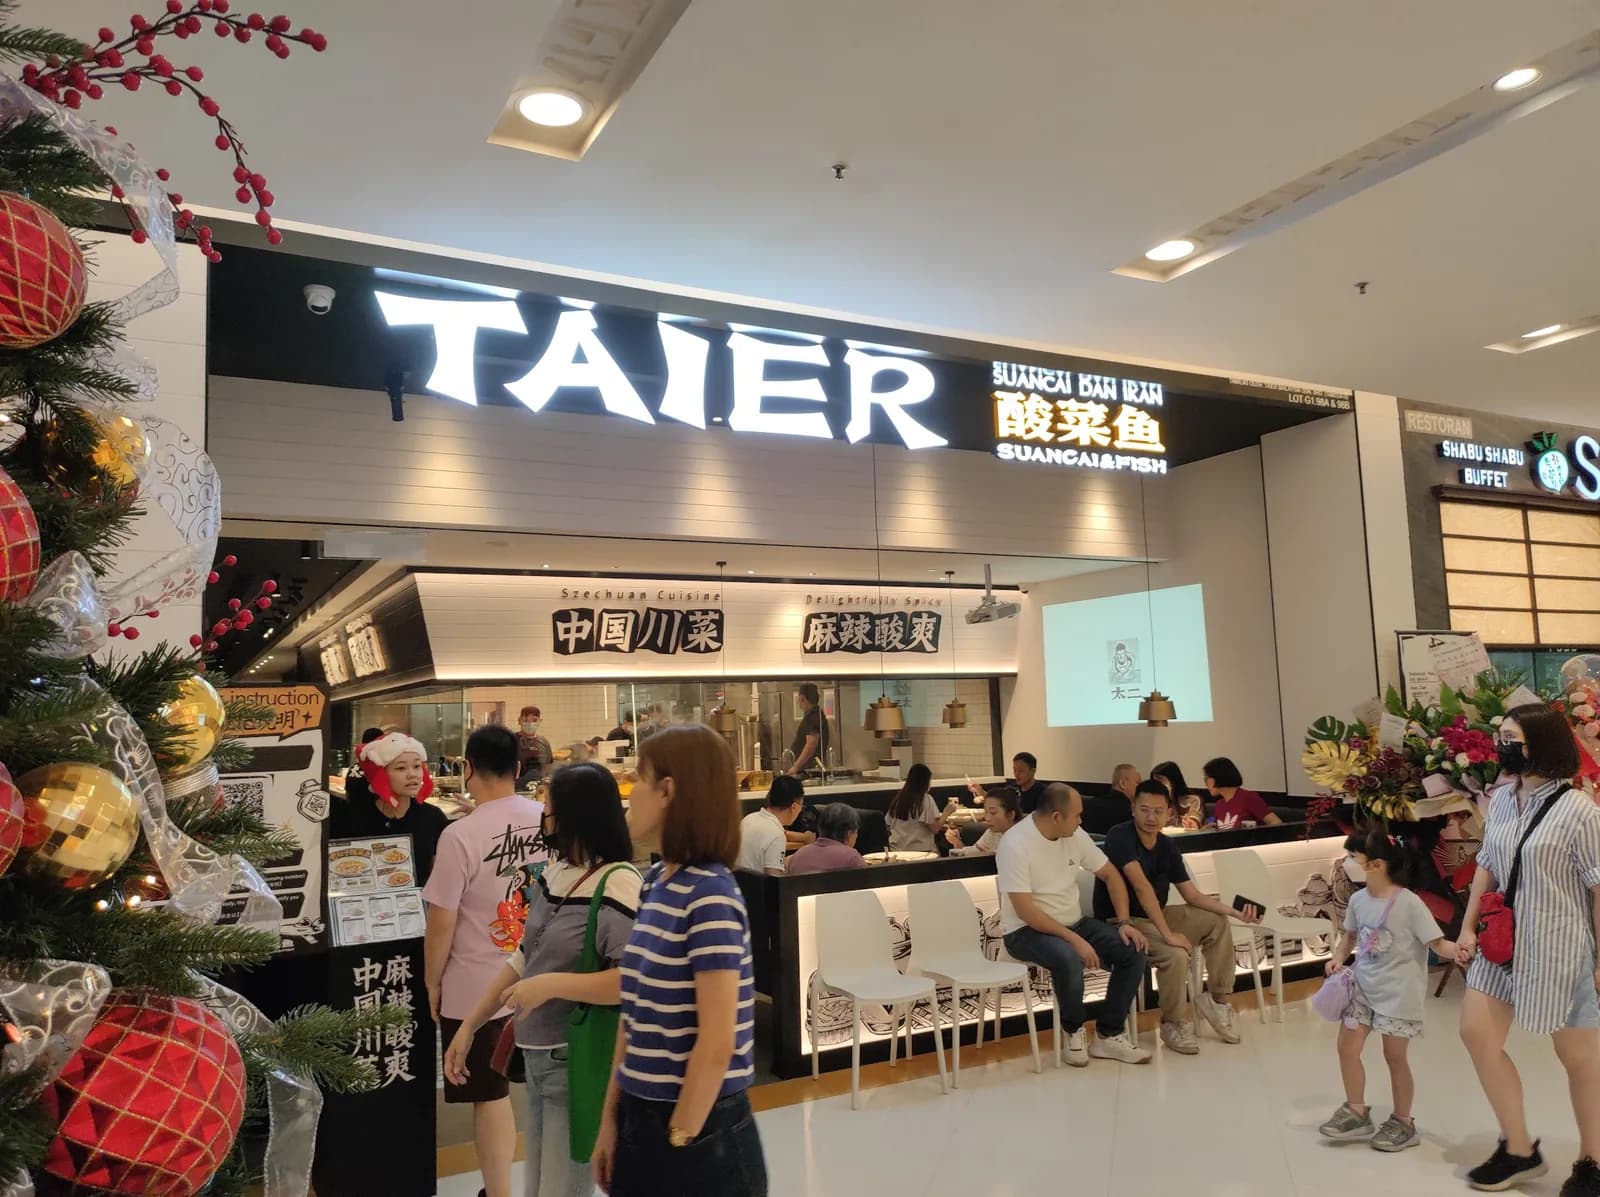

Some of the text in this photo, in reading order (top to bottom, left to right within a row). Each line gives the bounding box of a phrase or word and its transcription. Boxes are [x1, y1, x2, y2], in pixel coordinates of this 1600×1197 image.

[373, 289, 949, 450] TAIER
[992, 367, 1072, 394] SUANCAI
[1079, 379, 1117, 401] DAN
[1288, 393, 1303, 404] LOT
[992, 390, 1166, 453] 酸菜鱼
[1407, 414, 1471, 437] RESTORAN
[996, 443, 1168, 475] SUANCAI&FISH
[1442, 440, 1524, 466] SHABU SHABU
[1464, 467, 1509, 488] BUFFET
[561, 588, 721, 601] Szechuan Cuisine
[554, 609, 723, 654] 中国川菜
[803, 613, 938, 653] 麻辣酸爽
[230, 688, 319, 706] instruction
[1111, 686, 1142, 700] 太二
